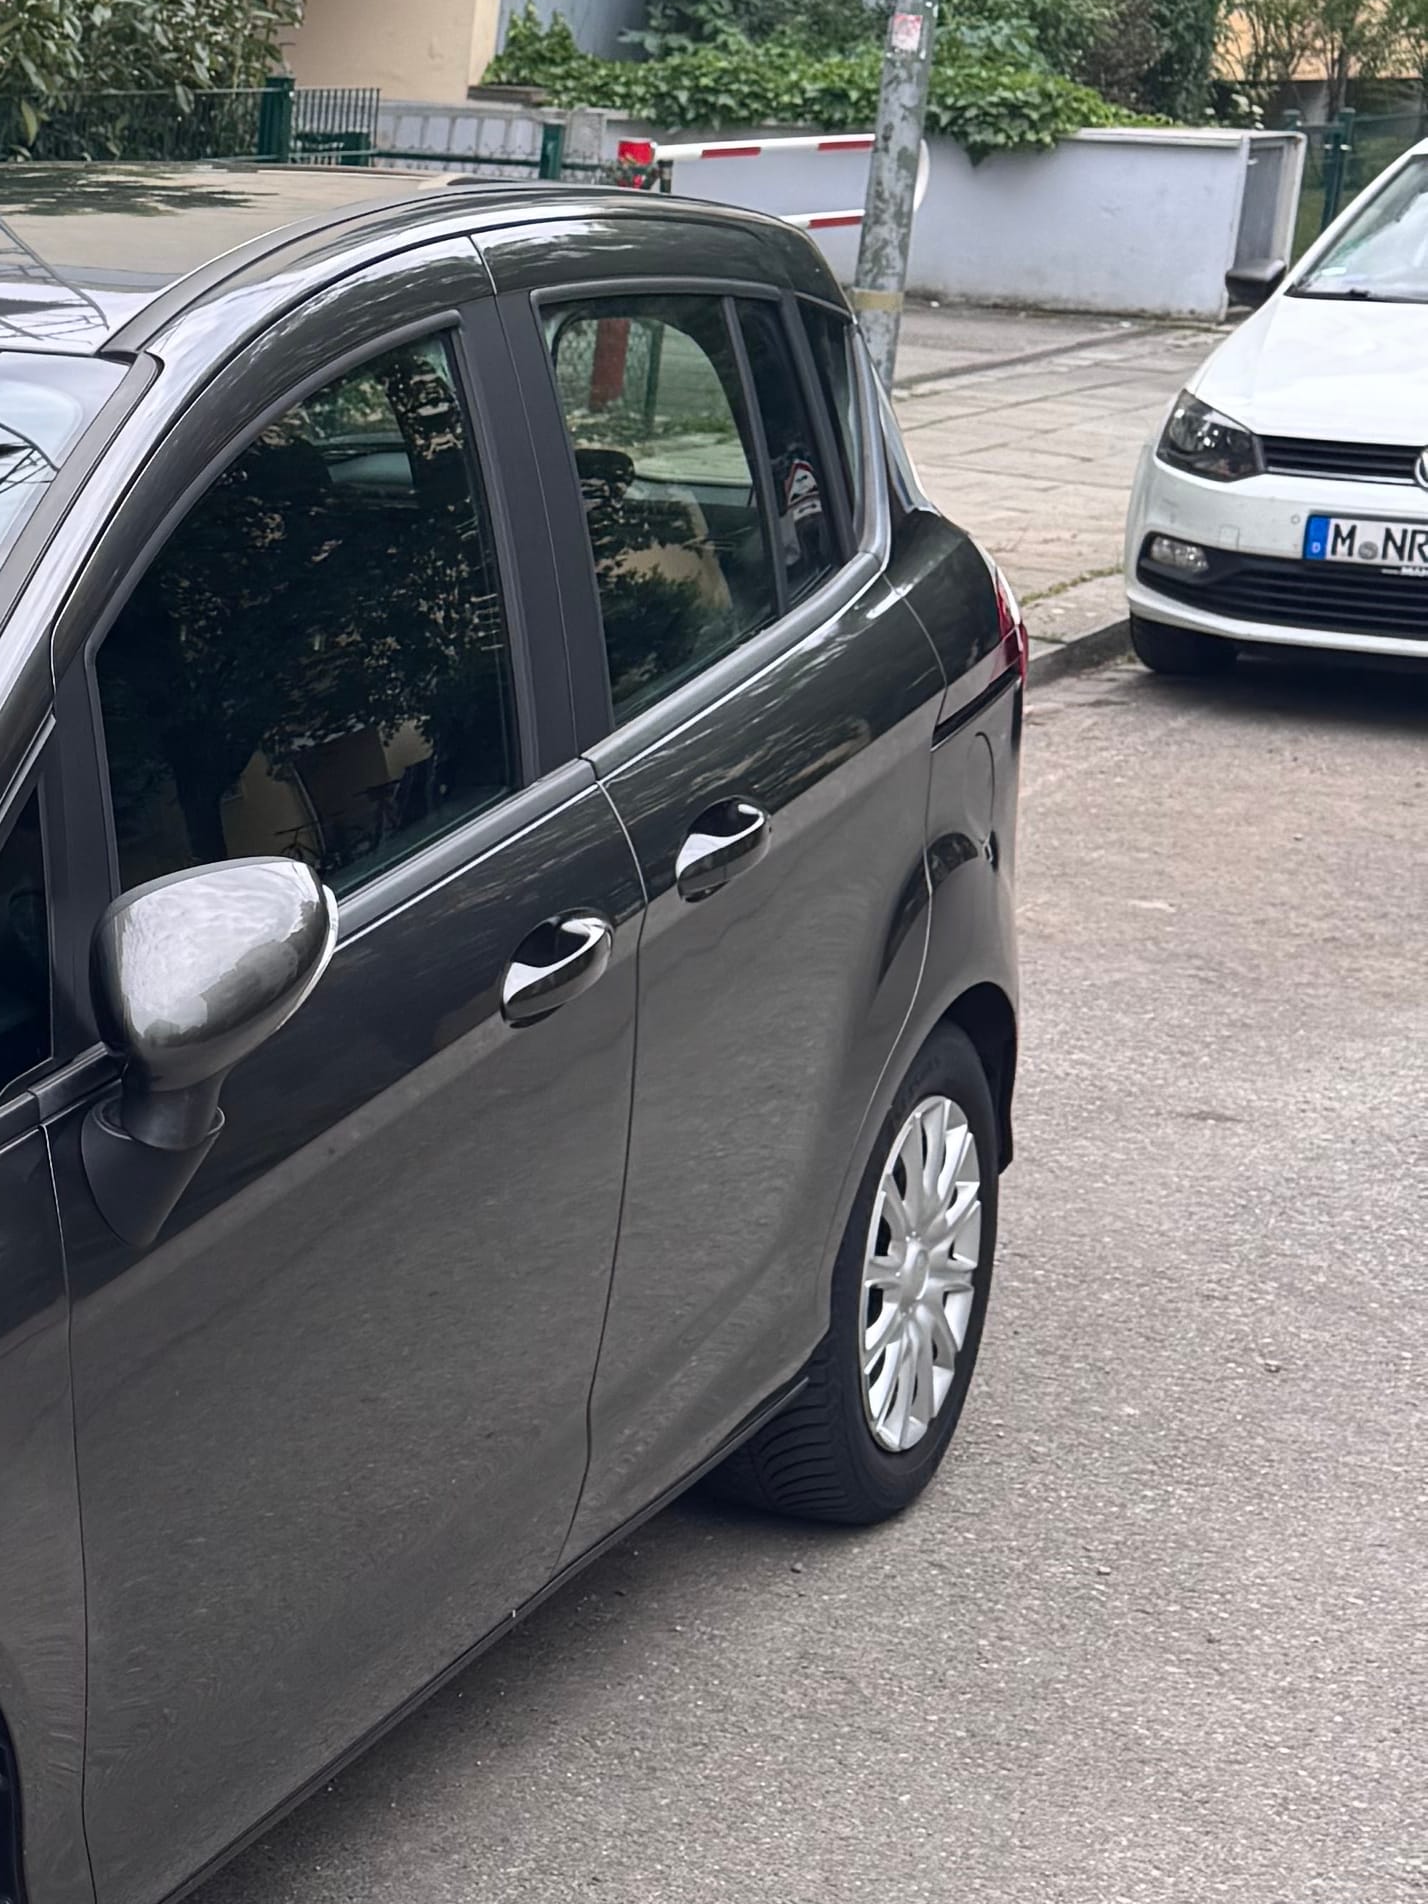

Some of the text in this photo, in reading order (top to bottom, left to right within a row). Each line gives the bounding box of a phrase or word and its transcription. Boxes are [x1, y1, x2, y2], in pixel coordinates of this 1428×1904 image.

[1311, 541, 1322, 554] D
[1330, 522, 1428, 563] M NR
